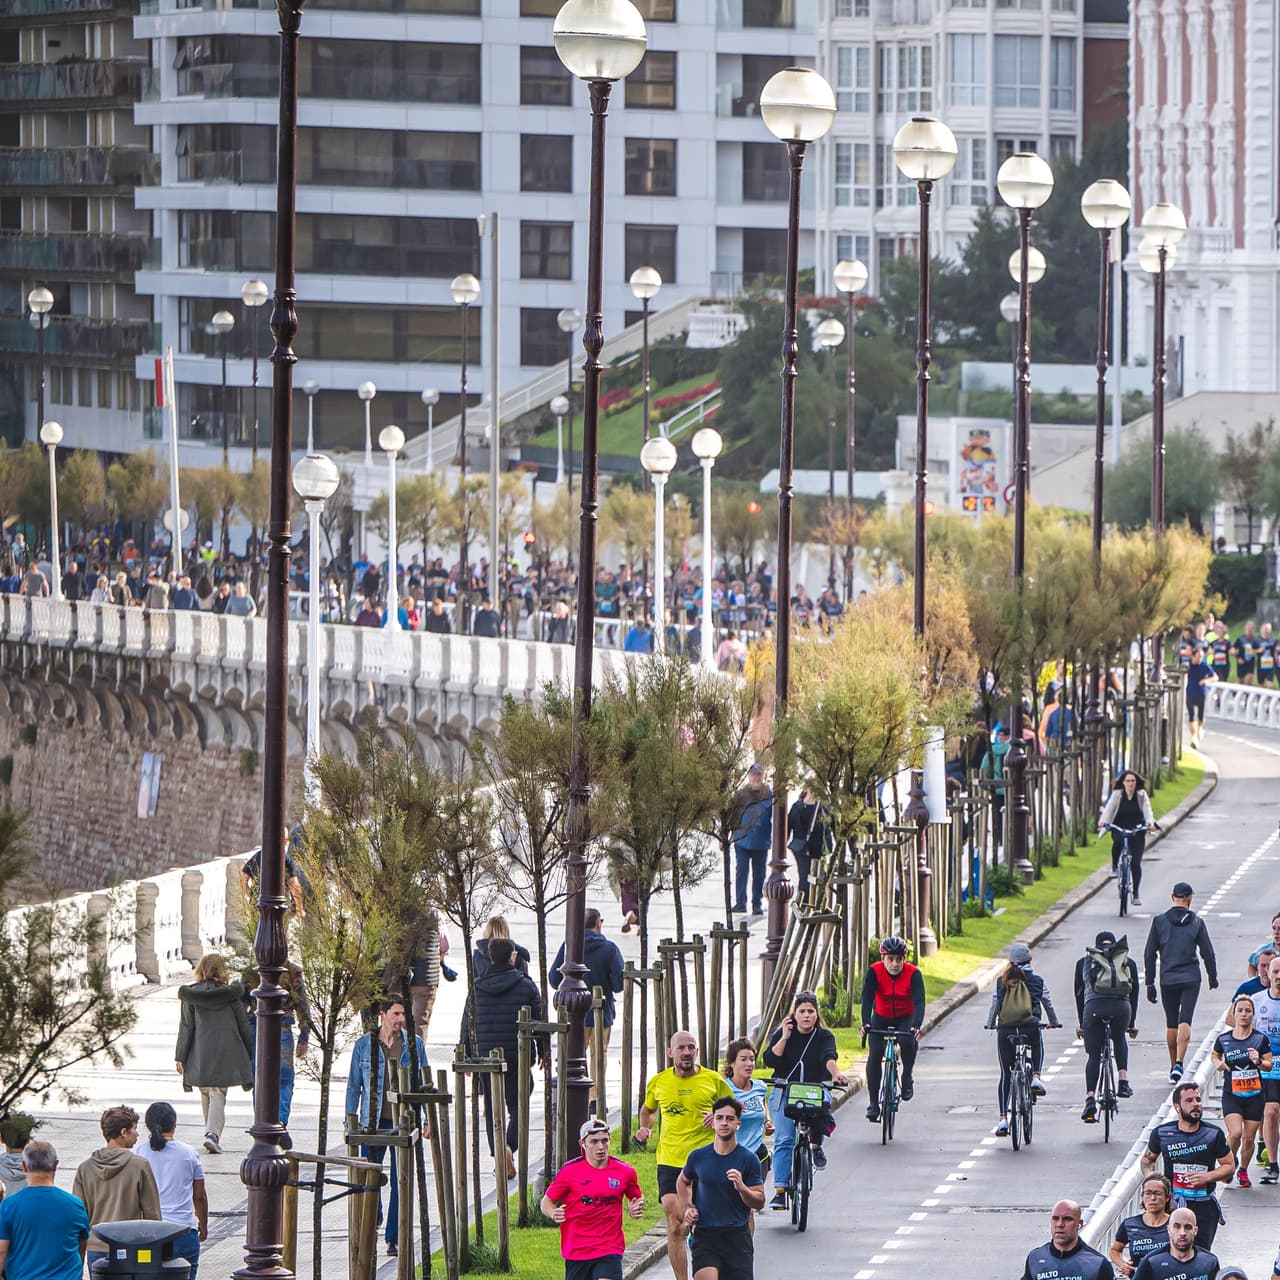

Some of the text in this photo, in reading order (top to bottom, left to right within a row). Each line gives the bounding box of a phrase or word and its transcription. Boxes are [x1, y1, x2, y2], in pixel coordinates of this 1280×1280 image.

[1168, 1143, 1208, 1158] FOUNDATION
[1133, 1238, 1153, 1246] SALTO
[1036, 1270, 1060, 1280] SALTO
